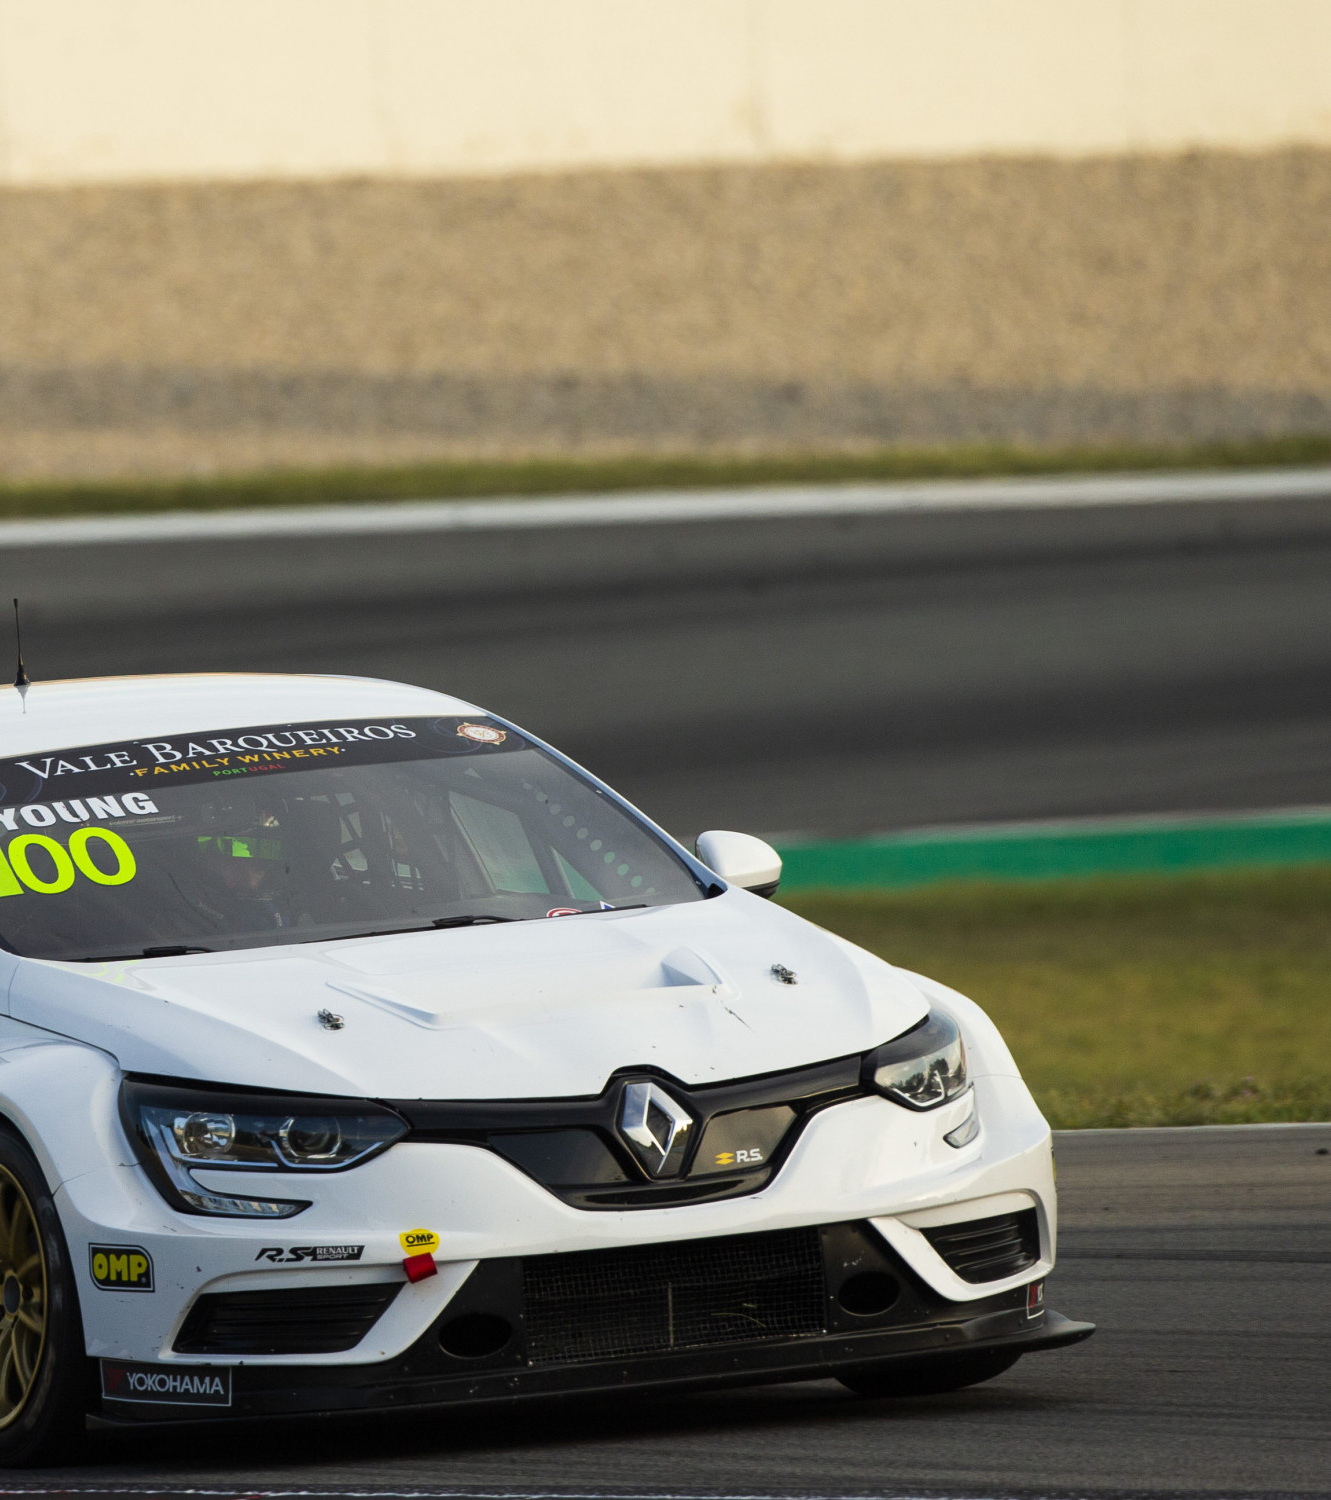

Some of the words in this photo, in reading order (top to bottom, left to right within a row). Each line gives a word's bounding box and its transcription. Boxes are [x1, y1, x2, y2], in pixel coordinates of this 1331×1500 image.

[15, 751, 137, 779] VALE
[141, 724, 417, 764] BARQUEIROS
[134, 757, 230, 777] FAMILY
[237, 746, 340, 764] WINERY
[213, 763, 287, 777] PORTUGAL
[735, 1148, 764, 1163] R.S.
[405, 1233, 434, 1244] OMP
[316, 1246, 359, 1255] RENAULT
[93, 1253, 148, 1282] OMP
[126, 1372, 225, 1395] YOKOHAMA
